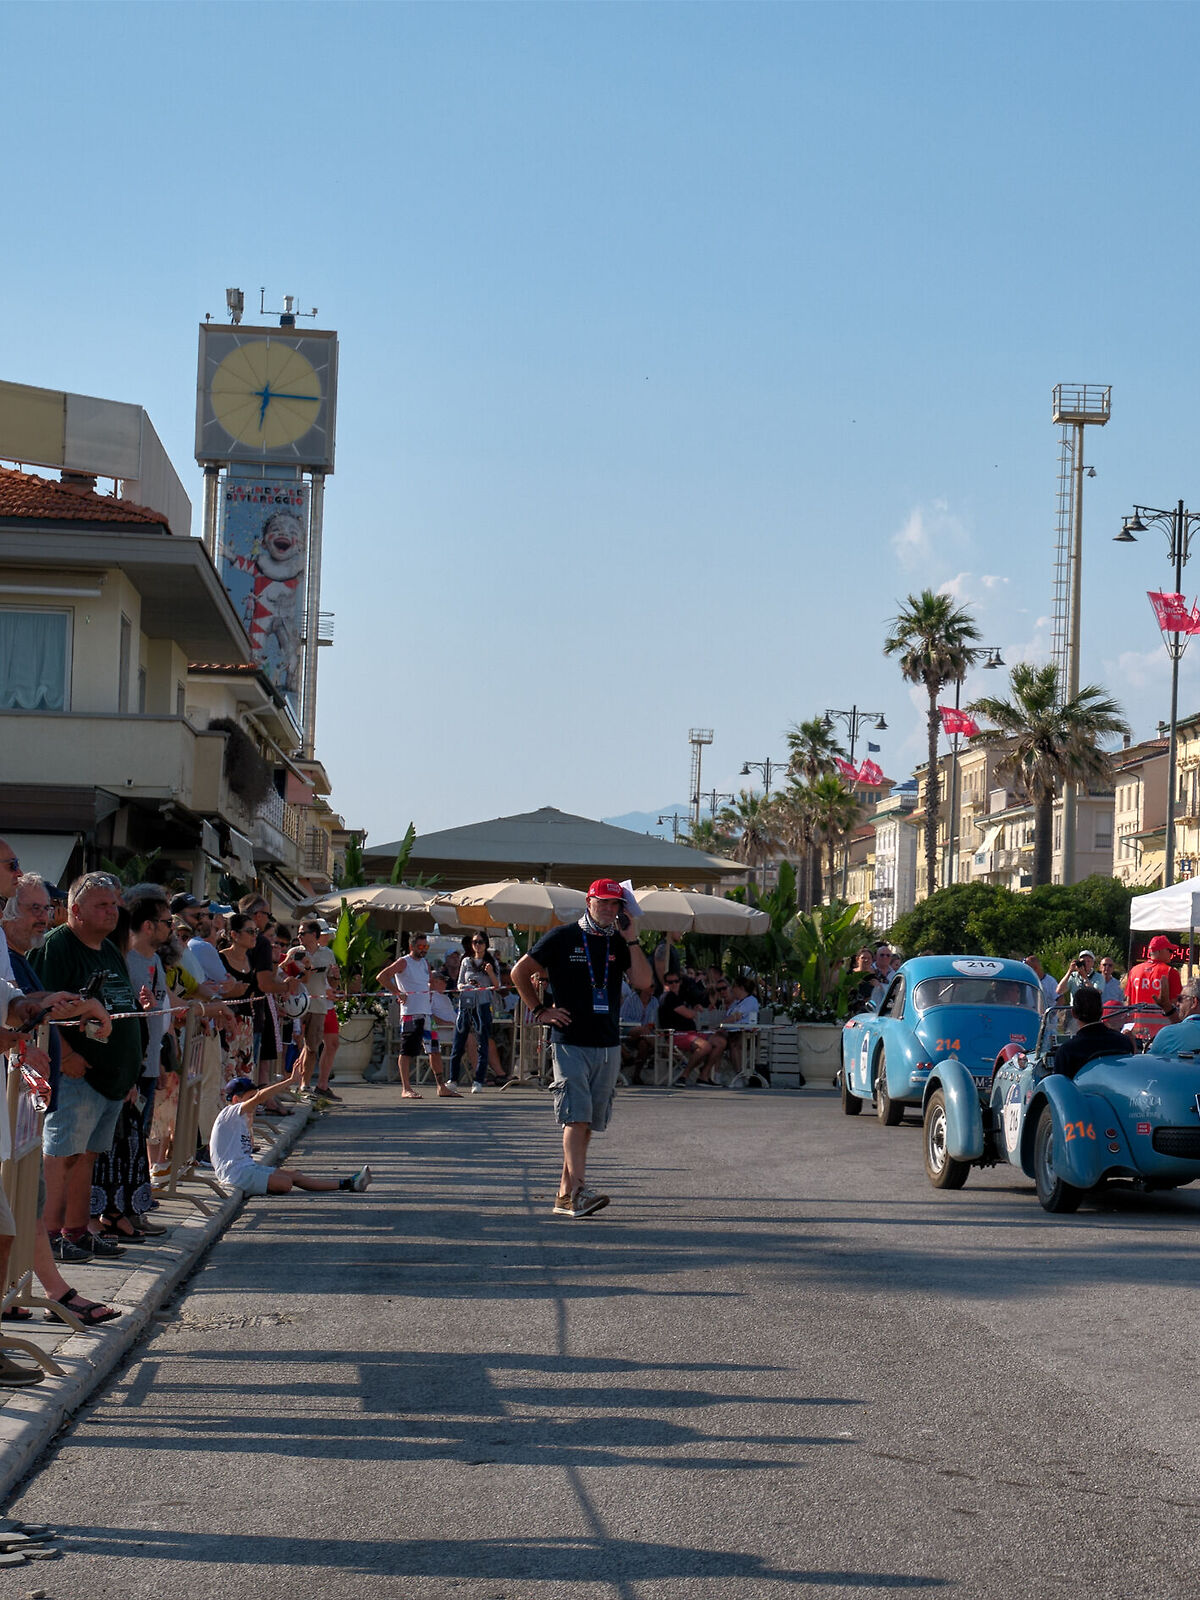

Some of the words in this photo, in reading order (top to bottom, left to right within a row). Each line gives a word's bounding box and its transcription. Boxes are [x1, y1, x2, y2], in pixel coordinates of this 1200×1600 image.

[967, 961, 996, 969] 214
[935, 1038, 961, 1051] 214
[1064, 1121, 1096, 1142] 216
